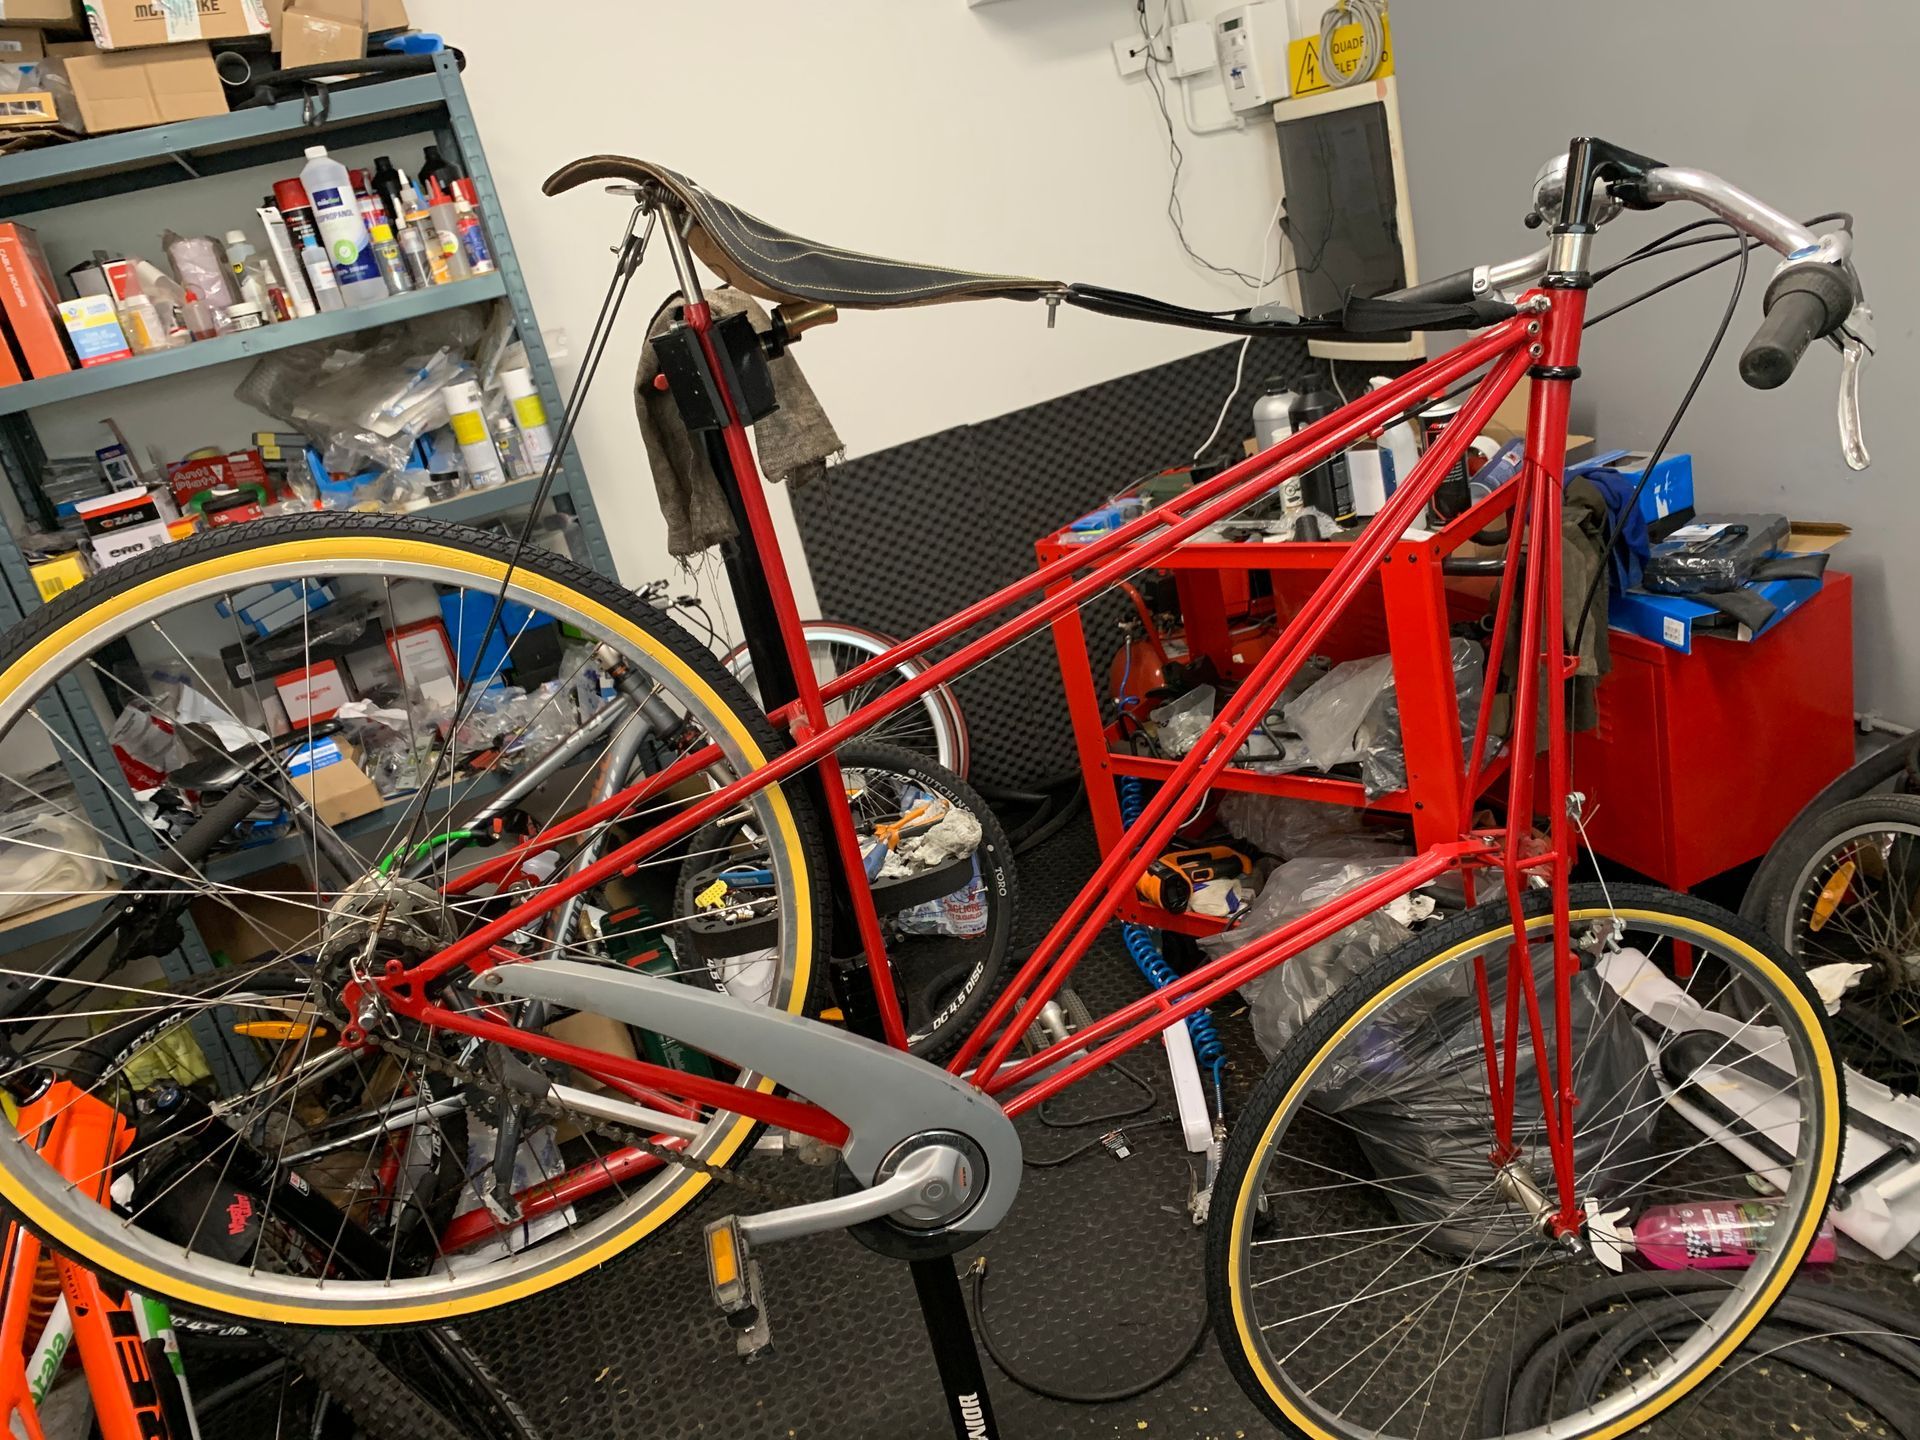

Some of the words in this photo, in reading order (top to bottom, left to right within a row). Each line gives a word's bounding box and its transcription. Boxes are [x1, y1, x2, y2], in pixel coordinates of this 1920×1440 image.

[995, 866, 1008, 898] TORO
[932, 1011, 949, 1031] DC
[949, 991, 966, 1014] 4.5
[965, 961, 985, 995] DISC
